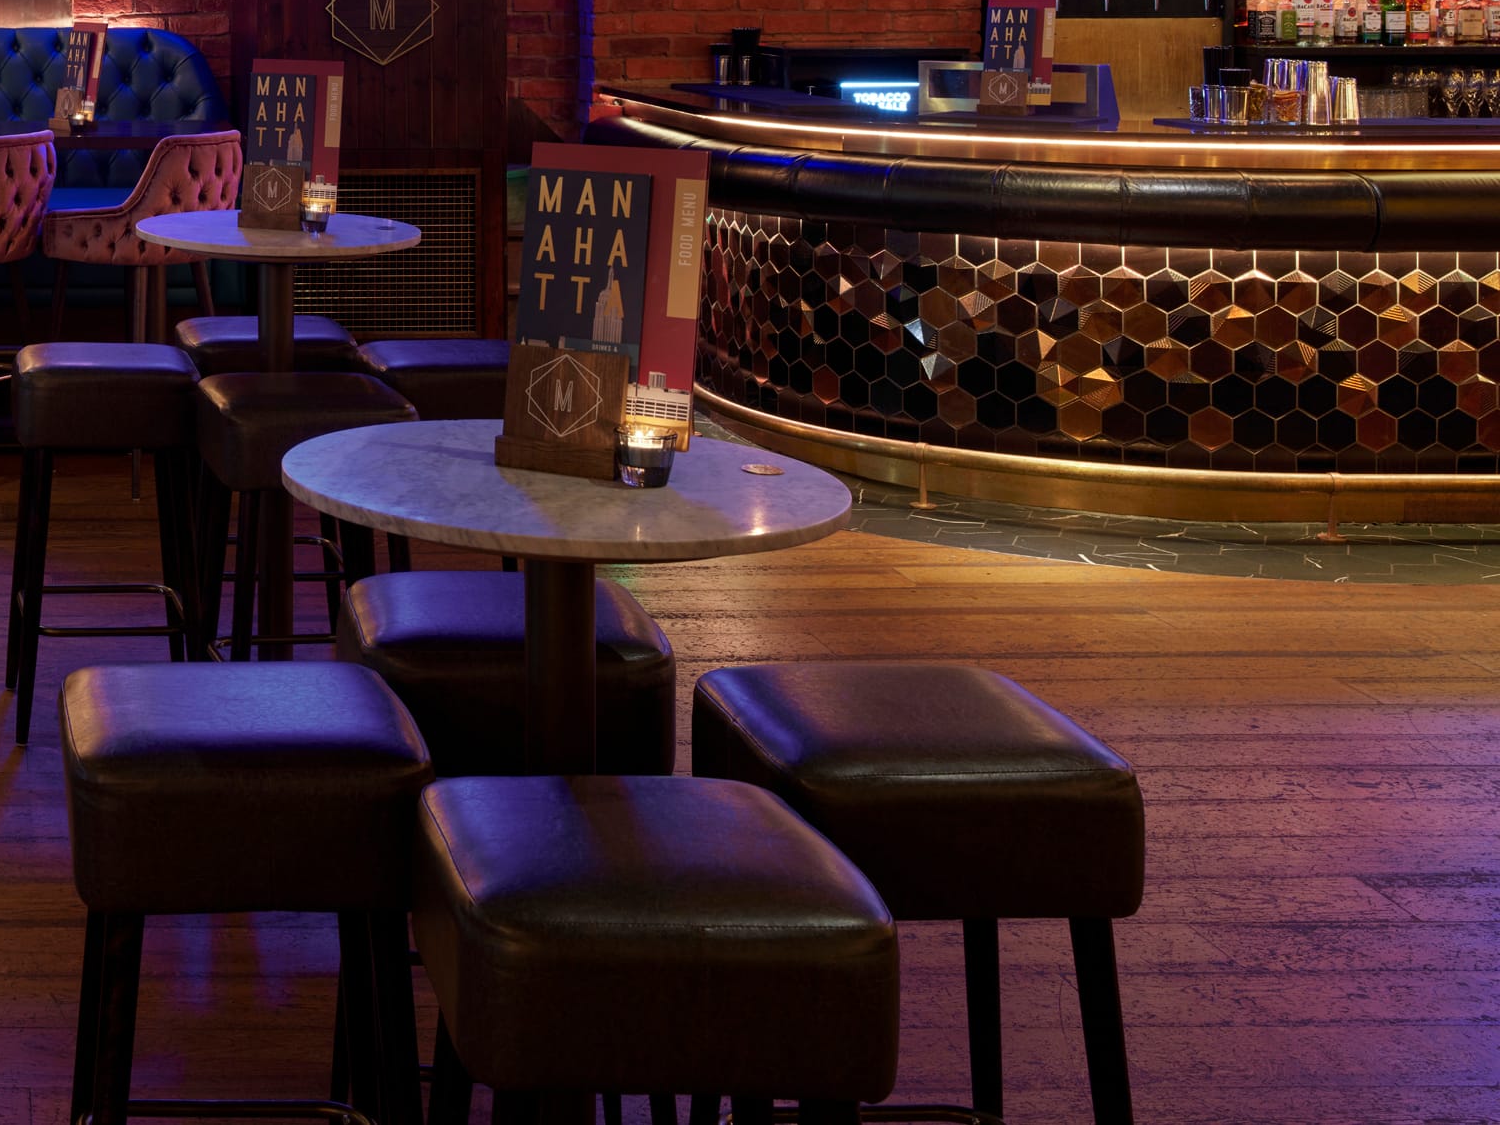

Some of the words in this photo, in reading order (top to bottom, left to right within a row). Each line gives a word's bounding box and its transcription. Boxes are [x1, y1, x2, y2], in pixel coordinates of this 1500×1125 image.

[990, 9, 1028, 24] MAN
[990, 27, 1027, 42] AHA
[256, 76, 307, 97] MAN
[853, 92, 911, 103] TOBACCO
[255, 102, 305, 122] AHA
[538, 175, 633, 219] MAN
[682, 192, 697, 227] MENU
[535, 224, 628, 268] AHA
[679, 233, 693, 266] FOOD
[553, 379, 574, 412] M
